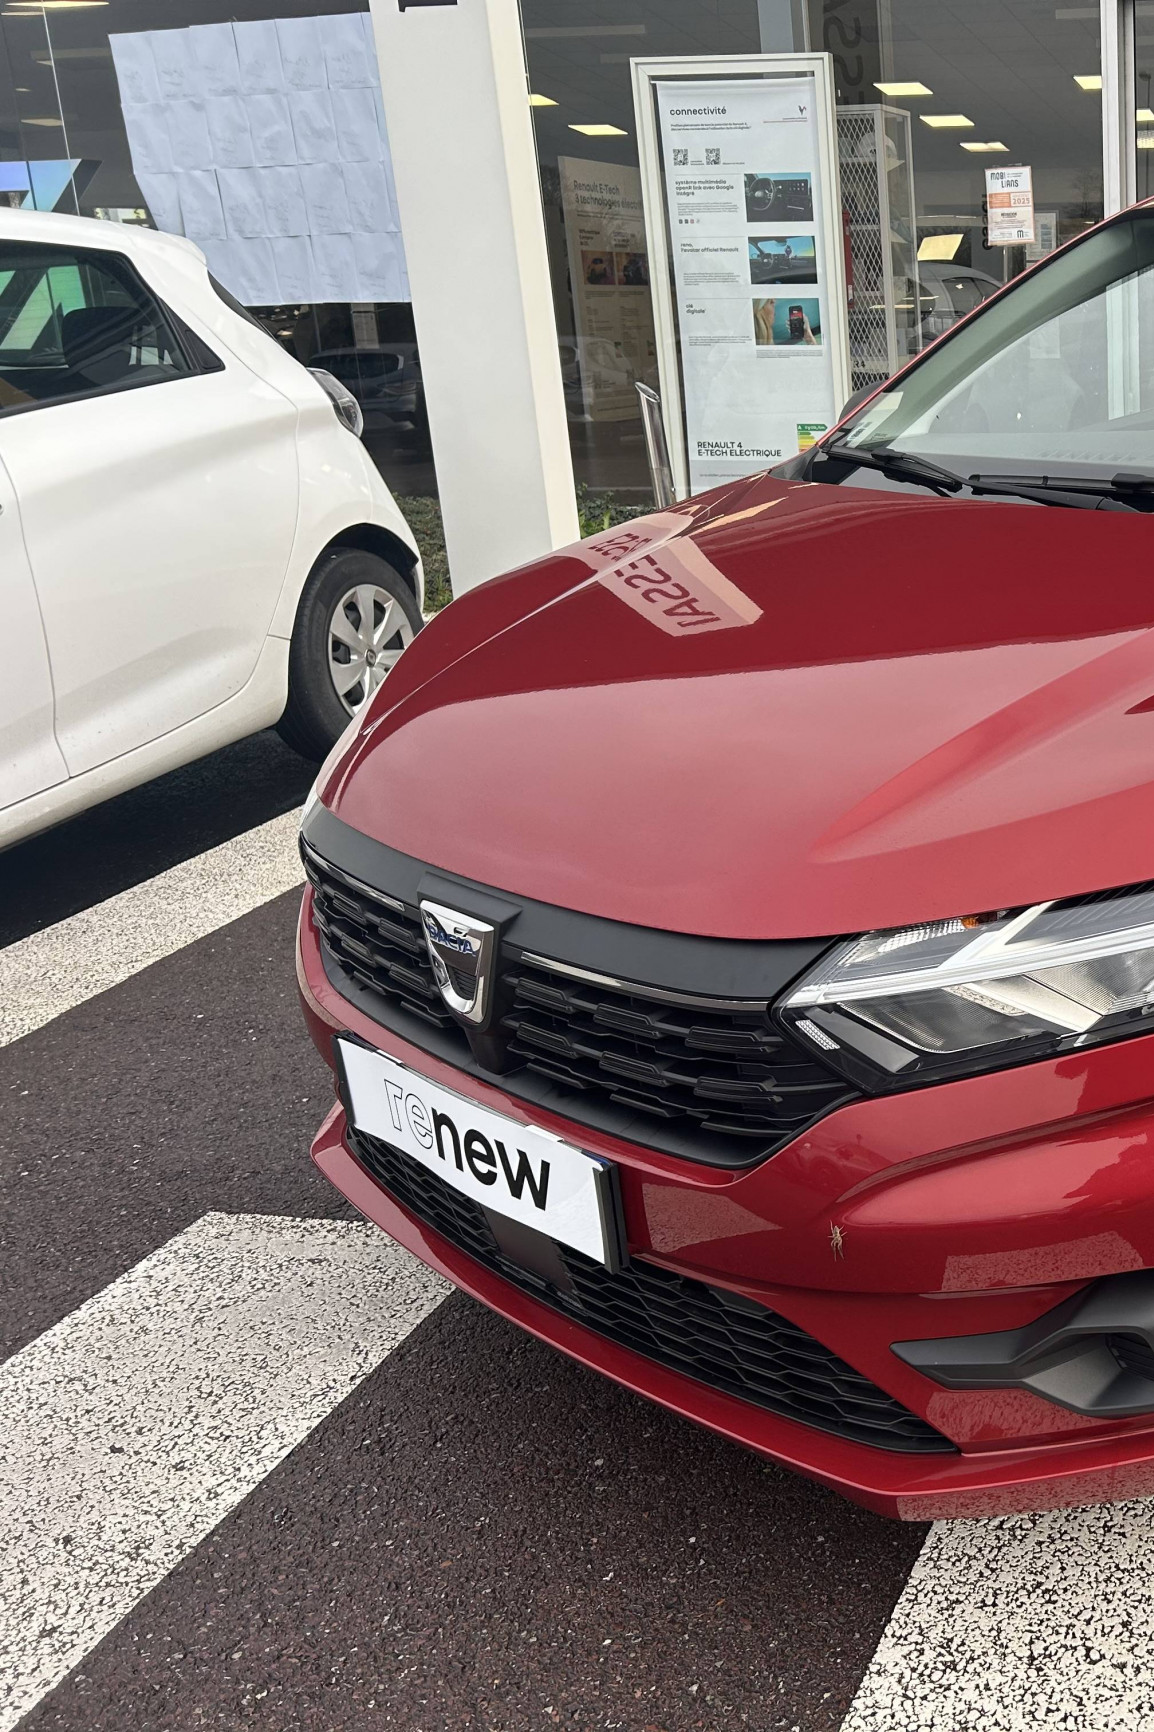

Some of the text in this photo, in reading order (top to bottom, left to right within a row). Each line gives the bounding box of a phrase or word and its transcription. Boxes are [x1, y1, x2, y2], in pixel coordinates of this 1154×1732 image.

[669, 105, 727, 116] connectivité
[573, 180, 598, 194] Renault
[1012, 197, 1031, 205] 2025
[697, 441, 743, 449] RENAULT 4
[697, 449, 782, 458] E-TECH ELECTRIQUE
[384, 1078, 551, 1211] renew
